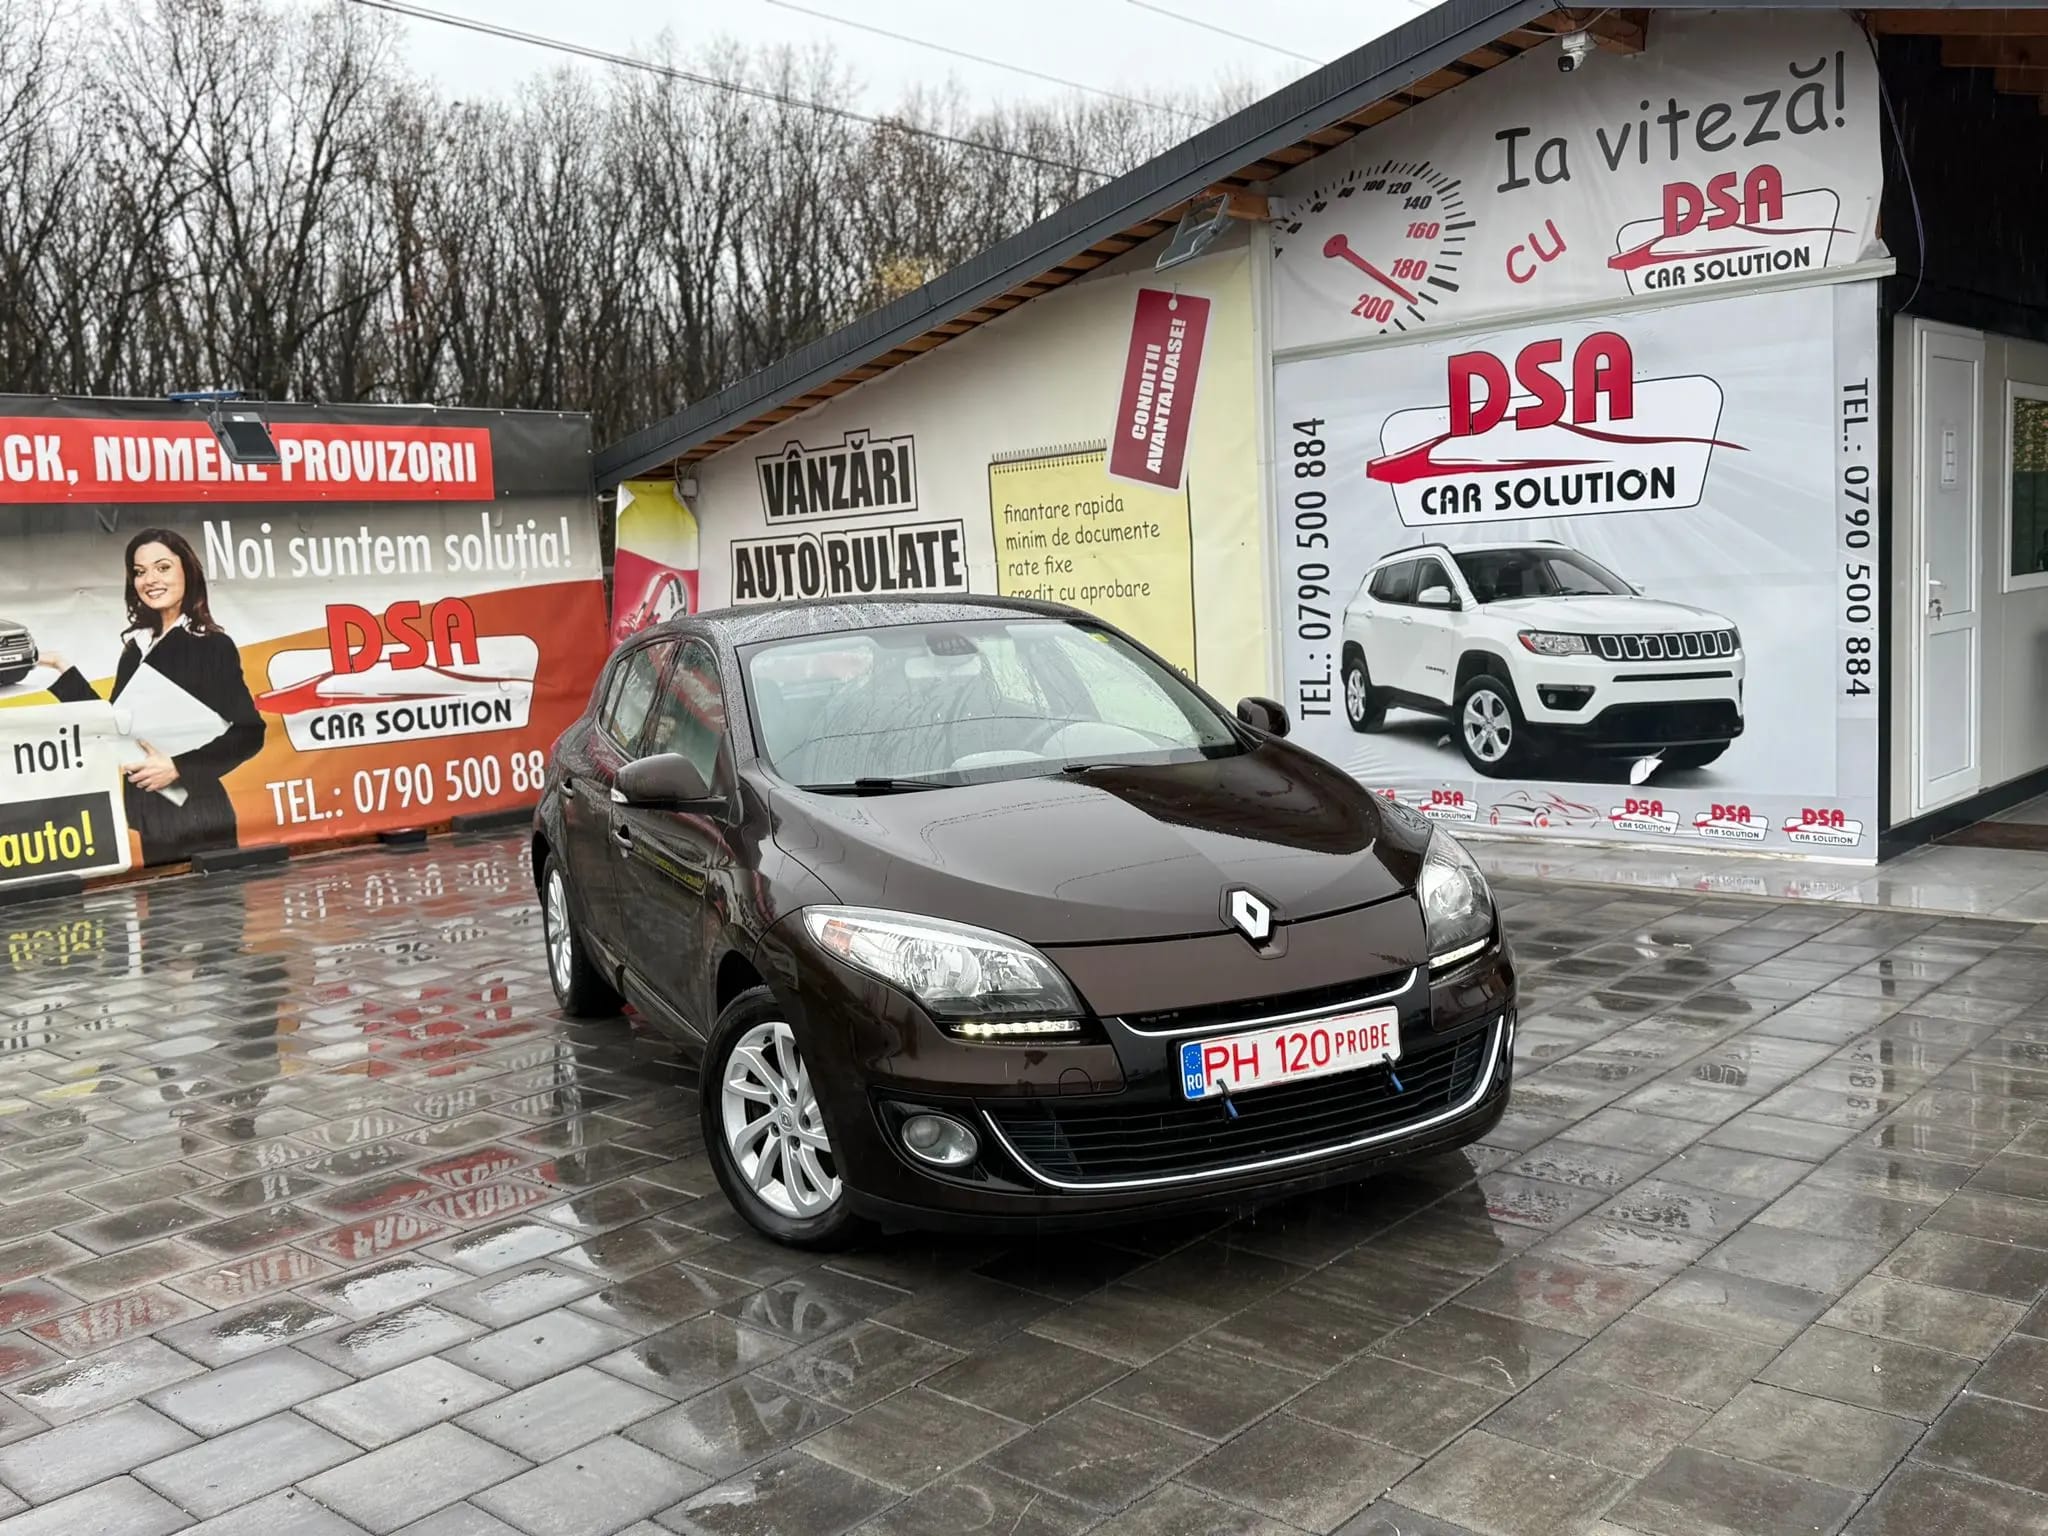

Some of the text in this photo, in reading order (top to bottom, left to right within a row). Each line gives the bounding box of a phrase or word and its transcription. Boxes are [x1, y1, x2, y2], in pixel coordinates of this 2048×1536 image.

[1495, 50, 1845, 194] Ia viteză!
[1363, 178, 1386, 192] 100
[1387, 181, 1412, 195] 120
[1403, 195, 1432, 210] 140
[1662, 163, 1783, 238] DSA
[1406, 222, 1440, 240] 160
[1506, 219, 1567, 284] cu
[1390, 258, 1428, 281] 180
[1644, 245, 1810, 289] CAR SOLUTION
[1351, 293, 1395, 324] 200
[1131, 343, 1161, 440] CONDITII
[1146, 318, 1187, 475] AVANTAJOASE!
[1447, 331, 1634, 436] DSA
[280, 438, 477, 483] PROVIZORII
[761, 439, 911, 517] VÂNZĂRI
[1004, 493, 1124, 524] finantare rapida
[1421, 466, 1676, 515] CAR SOLUTION
[203, 519, 276, 580] Noi
[289, 526, 432, 578] suntem
[1006, 521, 1160, 550] minim de documente
[1843, 377, 1871, 697] TEL.: 0790 500 884
[736, 529, 963, 600] AUTO RULATE
[1009, 555, 1073, 577] rate fixe
[1292, 418, 1332, 720] TEL.: 0790 500 884
[1059, 585, 1076, 601] cu
[1080, 578, 1151, 605] aprobare
[326, 597, 480, 675] DSA
[310, 699, 512, 741] CAR SOLUTION
[13, 724, 83, 775] noi!
[265, 778, 344, 826] TEL.:
[353, 763, 433, 813] 0790
[446, 755, 500, 802] 500
[1431, 789, 1464, 806] DSA
[1625, 798, 1663, 817] DSA
[1440, 812, 1472, 820] SOLUTION
[1635, 823, 1671, 833] SOLUTION
[1705, 828, 1759, 839] CAR SOLUTION
[1711, 804, 1751, 823] DSA
[1802, 808, 1844, 827] DSA
[0, 810, 95, 868] auto!
[1795, 834, 1853, 845] CAR SOLUTION
[1187, 1023, 1391, 1091] RO PH 120 PROBE
